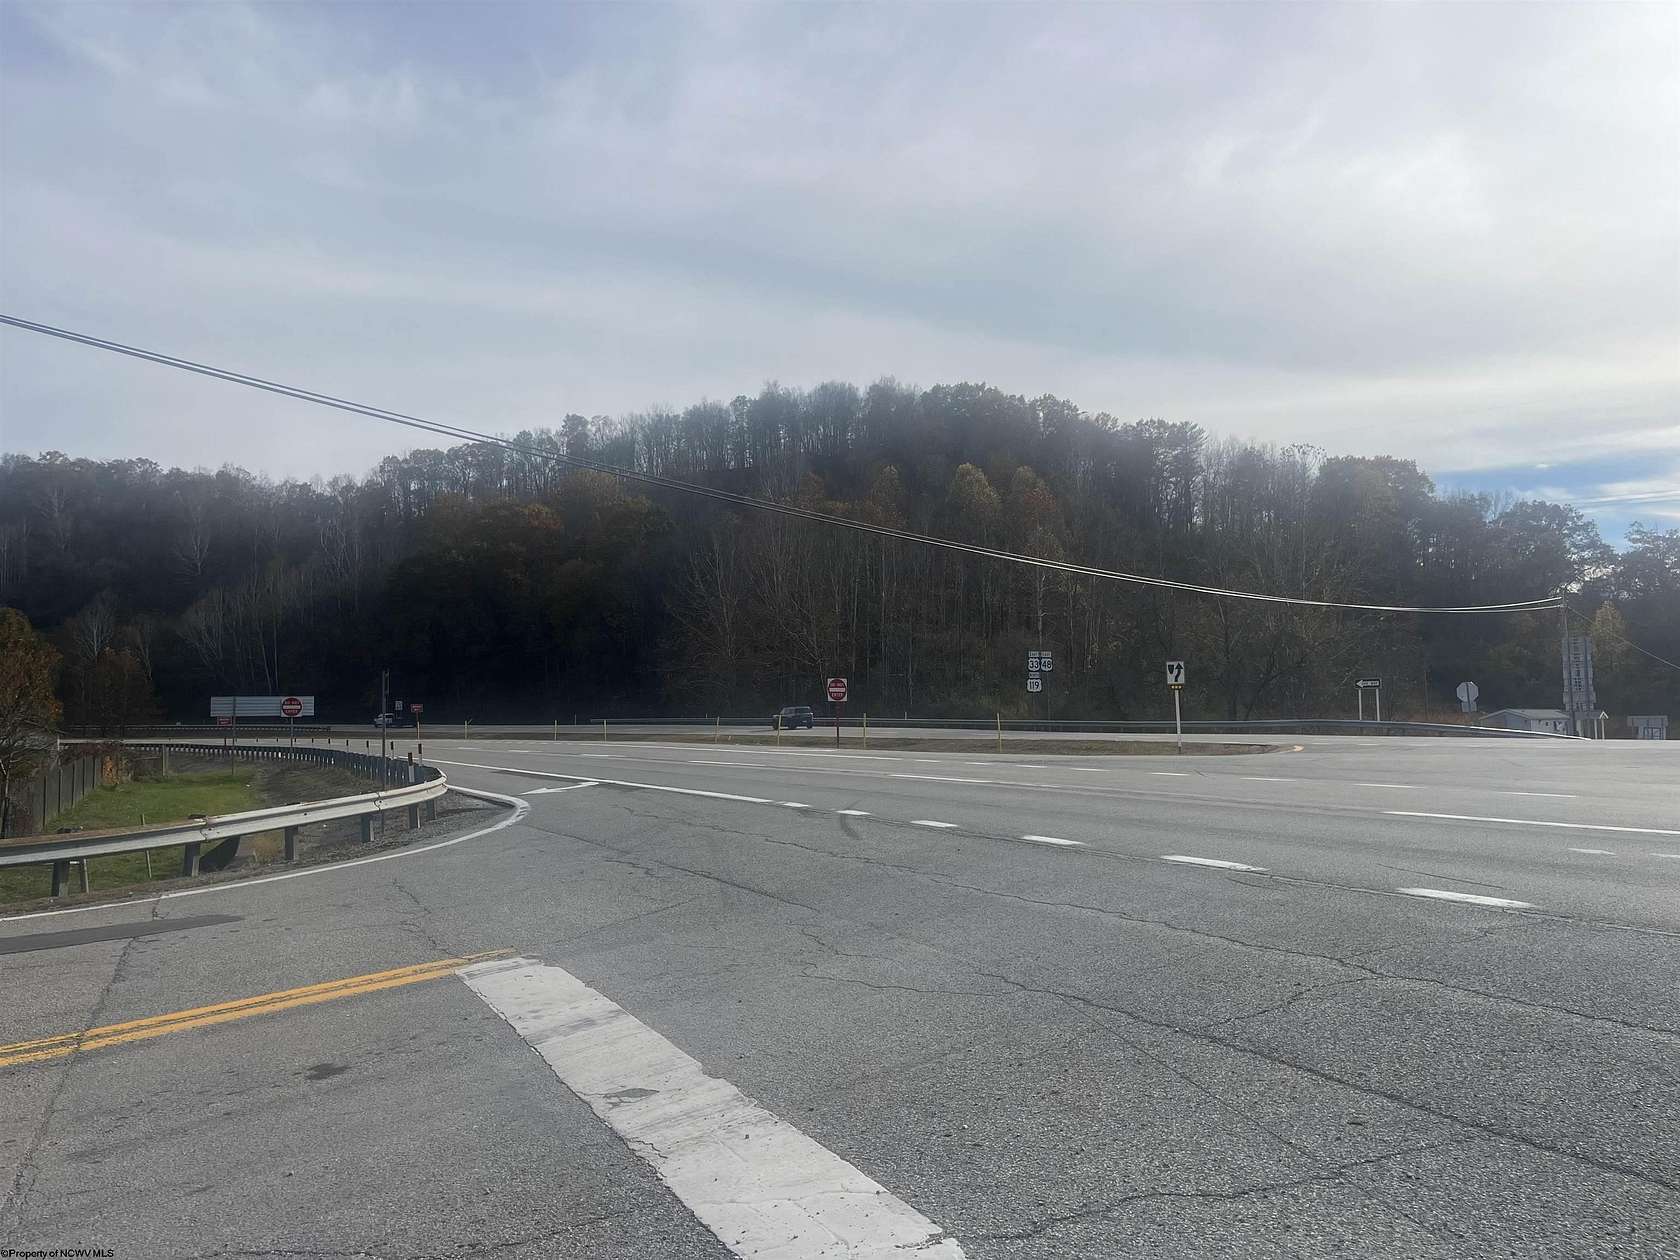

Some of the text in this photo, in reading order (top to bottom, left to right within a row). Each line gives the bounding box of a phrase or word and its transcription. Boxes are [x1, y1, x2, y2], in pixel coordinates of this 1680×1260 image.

[1030, 660, 1039, 669] 33
[1042, 660, 1051, 669] 48
[1030, 681, 1039, 689] 119
